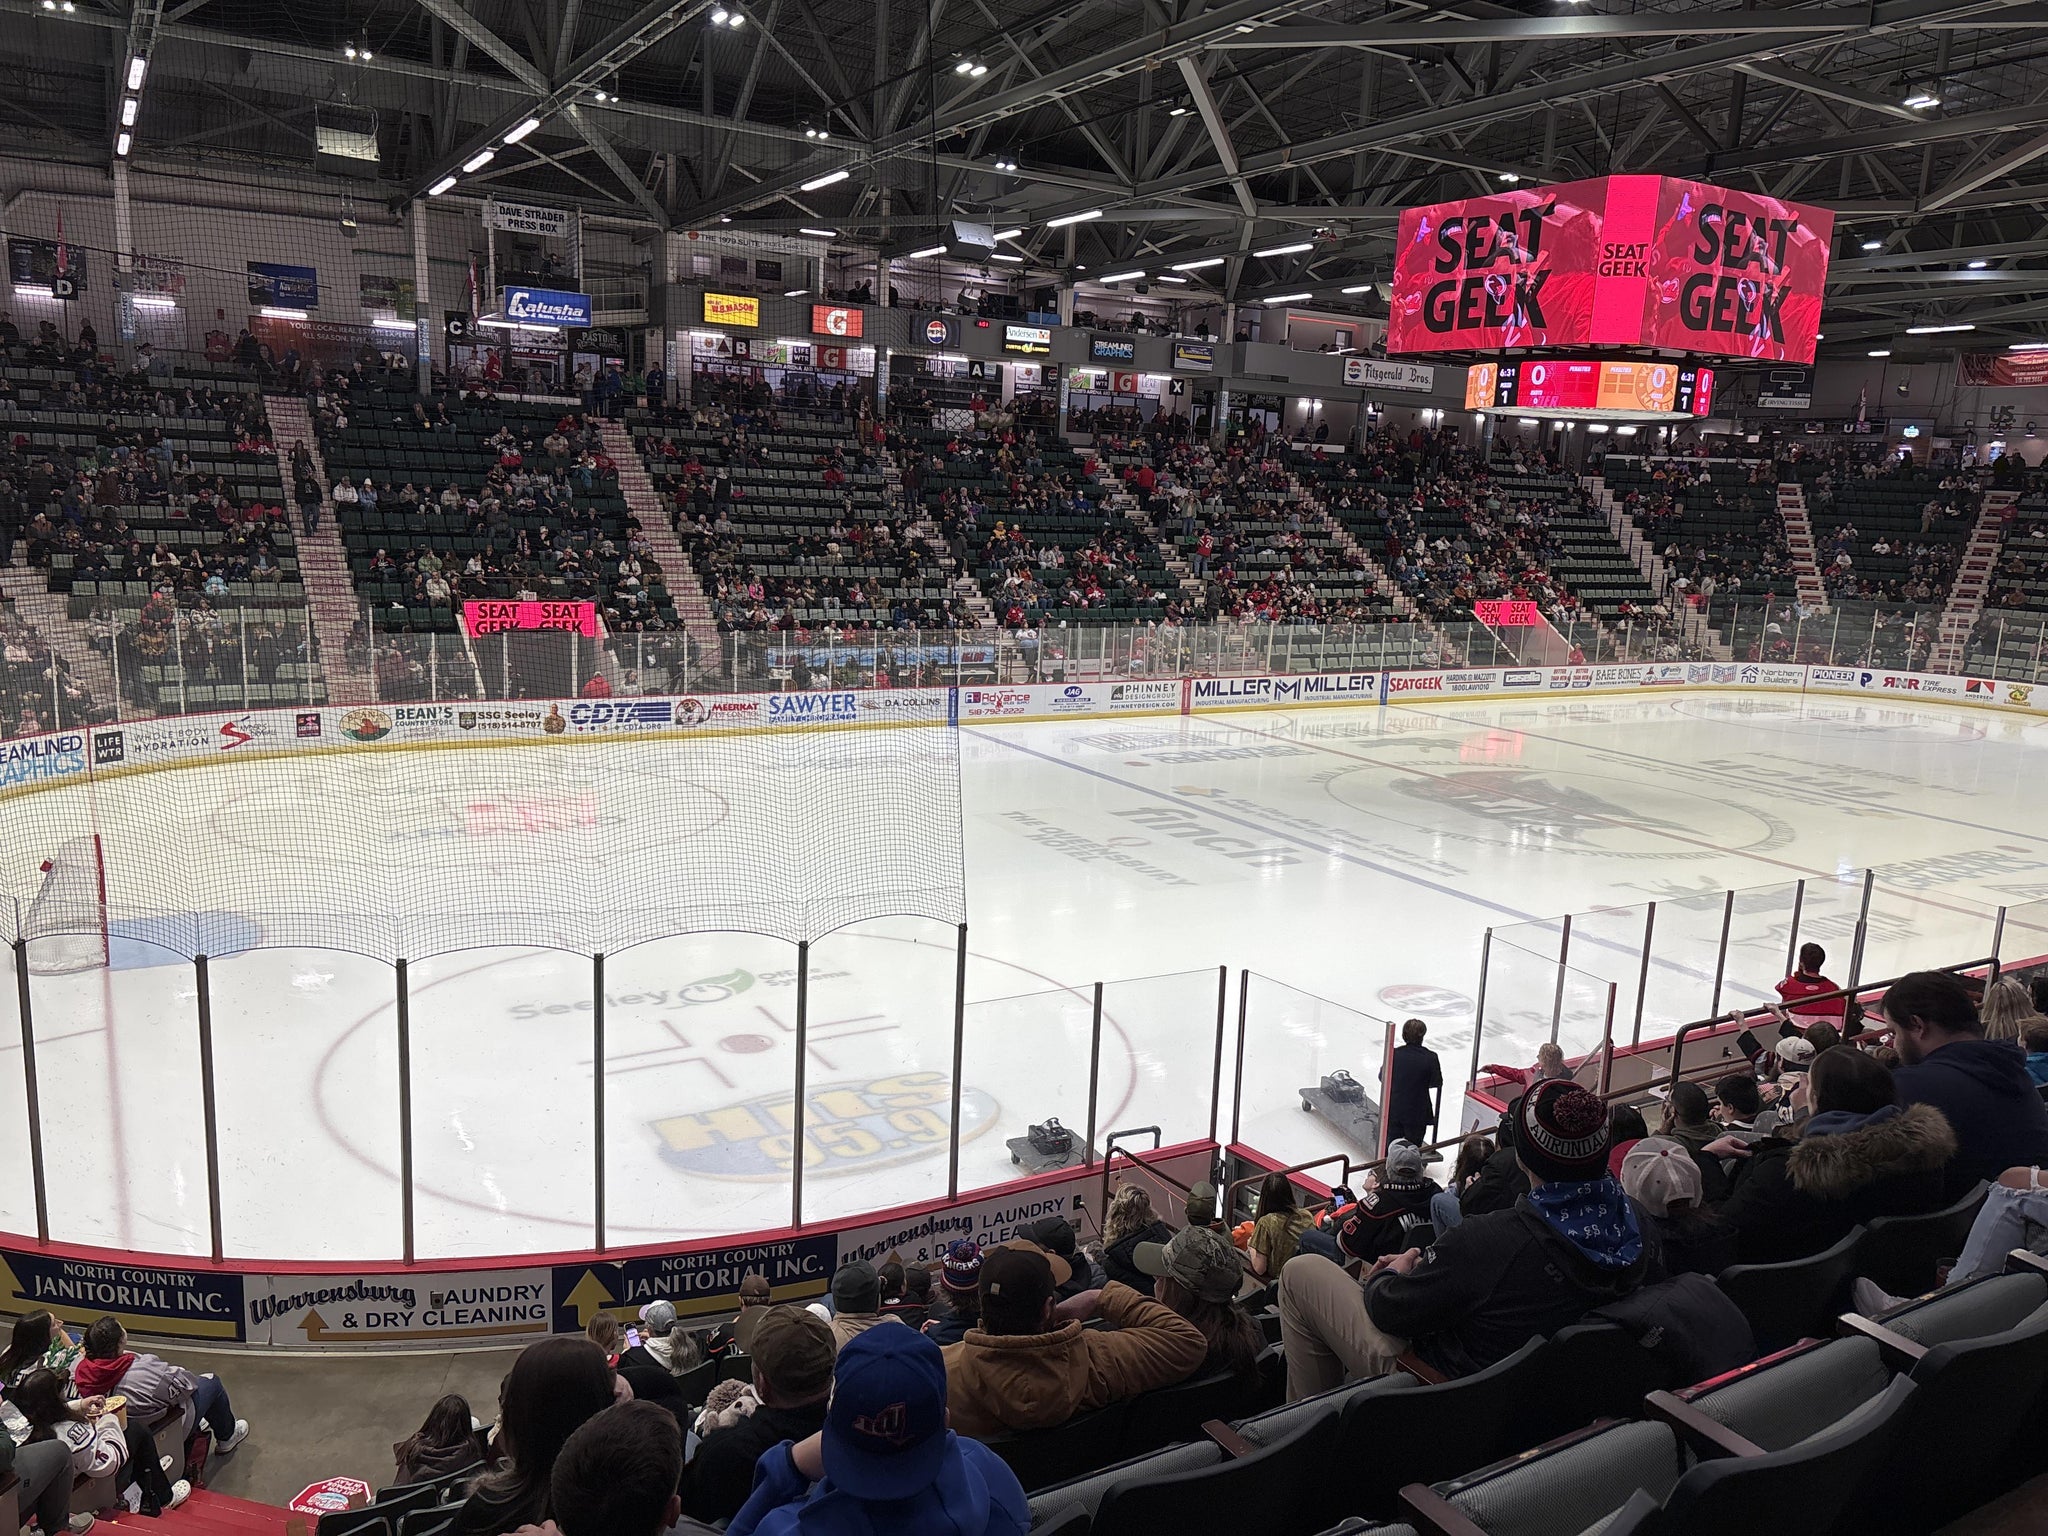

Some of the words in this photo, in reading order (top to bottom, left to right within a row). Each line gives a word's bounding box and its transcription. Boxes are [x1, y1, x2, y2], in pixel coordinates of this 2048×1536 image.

[499, 206, 522, 219] DAVE
[525, 210, 565, 223] STRADER
[508, 218, 537, 232] PRESS
[540, 222, 557, 233] BOX
[702, 234, 717, 242] THE
[1434, 203, 1555, 274] SEAT
[1694, 204, 1797, 282] SEAT
[1604, 243, 1650, 268] SEAT
[1600, 265, 1648, 288] GEEK
[57, 279, 72, 295] D
[508, 292, 584, 318] Galusha
[1423, 269, 1552, 334] GEEK
[1680, 276, 1791, 345] GEEK
[290, 322, 312, 331] YOUR
[313, 324, 338, 334] LOCAL
[449, 322, 463, 335] C
[1006, 327, 1038, 339] Andersen
[735, 342, 748, 355] B
[794, 346, 810, 355] LIFE
[1094, 340, 1134, 351] STREAMLINED
[794, 354, 810, 364] WTR
[823, 349, 840, 368] G
[1094, 349, 1133, 359] GRAPHICS
[971, 363, 983, 377] A
[1364, 363, 1403, 382] Fitzgerald
[1408, 367, 1432, 385] Bros.
[1499, 368, 1516, 377] 6:31
[1531, 365, 1546, 386] 0
[1680, 372, 1695, 382] 6:31
[1118, 375, 1132, 393] G
[1652, 368, 1666, 388] 0
[1172, 380, 1183, 393] X
[1501, 390, 1509, 404] 1
[1681, 395, 1688, 410] 1
[1374, 402, 1383, 410] W
[477, 603, 520, 619] SEAT
[541, 603, 582, 619] SEAT
[1481, 603, 1502, 614] SEAT
[1511, 603, 1532, 614] SEAT
[1480, 614, 1502, 625] GEEK
[1508, 614, 1530, 625] GEEK
[1761, 669, 1803, 678] Northern
[1763, 676, 1799, 684] Builders
[1813, 670, 1853, 681] PIONEER
[1066, 687, 1081, 695] JAG
[1125, 683, 1177, 694] PHINNEY
[1195, 678, 1272, 698] MILLER
[1305, 675, 1375, 693] MILLER
[1389, 676, 1443, 693] SEATGEEK
[1921, 685, 1958, 695] EXPRESS
[1924, 679, 1942, 688] TIRE
[712, 703, 759, 711] MEERKAT
[769, 694, 857, 714] SAWYER
[903, 698, 941, 706] COLLINS
[1110, 702, 1175, 710] PHINNEYDESIGN.COM
[1195, 699, 1225, 707] INDUSTRIAL
[1226, 697, 1270, 706] MANUFACTURING
[395, 707, 454, 721] BEAN'S
[477, 711, 502, 720] SSG
[505, 710, 542, 721] Seeley
[570, 702, 672, 725] CDTA
[395, 720, 429, 728] COUNTRY
[430, 719, 453, 727] STORE
[97, 737, 121, 748] LIFE
[134, 730, 174, 743] WHOLE
[178, 728, 208, 738] BODY
[134, 737, 209, 753] HYDRATION
[97, 748, 122, 759] WTR
[1000, 811, 1043, 827] THE
[1042, 826, 1200, 886] QUEENSBURY
[1026, 833, 1101, 862] HOTEL
[510, 989, 662, 1019] Seeley
[654, 1071, 953, 1153] HITS
[757, 1108, 952, 1172] 95.9
[982, 1197, 1065, 1229] LAUNDRY
[841, 1215, 973, 1265] Warrensburg
[662, 1253, 717, 1272] NORTH
[724, 1243, 796, 1264] COUNTRY
[917, 1251, 929, 1262] &
[941, 1254, 980, 1272] RANGERS
[64, 1263, 116, 1281] NORTH
[122, 1270, 197, 1288] COUNTRY
[628, 1264, 772, 1302] JANITORIAL
[777, 1254, 826, 1279] INC.
[35, 1275, 172, 1310] JANITORIAL
[178, 1292, 231, 1314] INC.
[250, 1279, 417, 1326] Warrensburg
[342, 1312, 358, 1328] &
[366, 1311, 414, 1328] DRY
[422, 1304, 547, 1326] CLEANING
